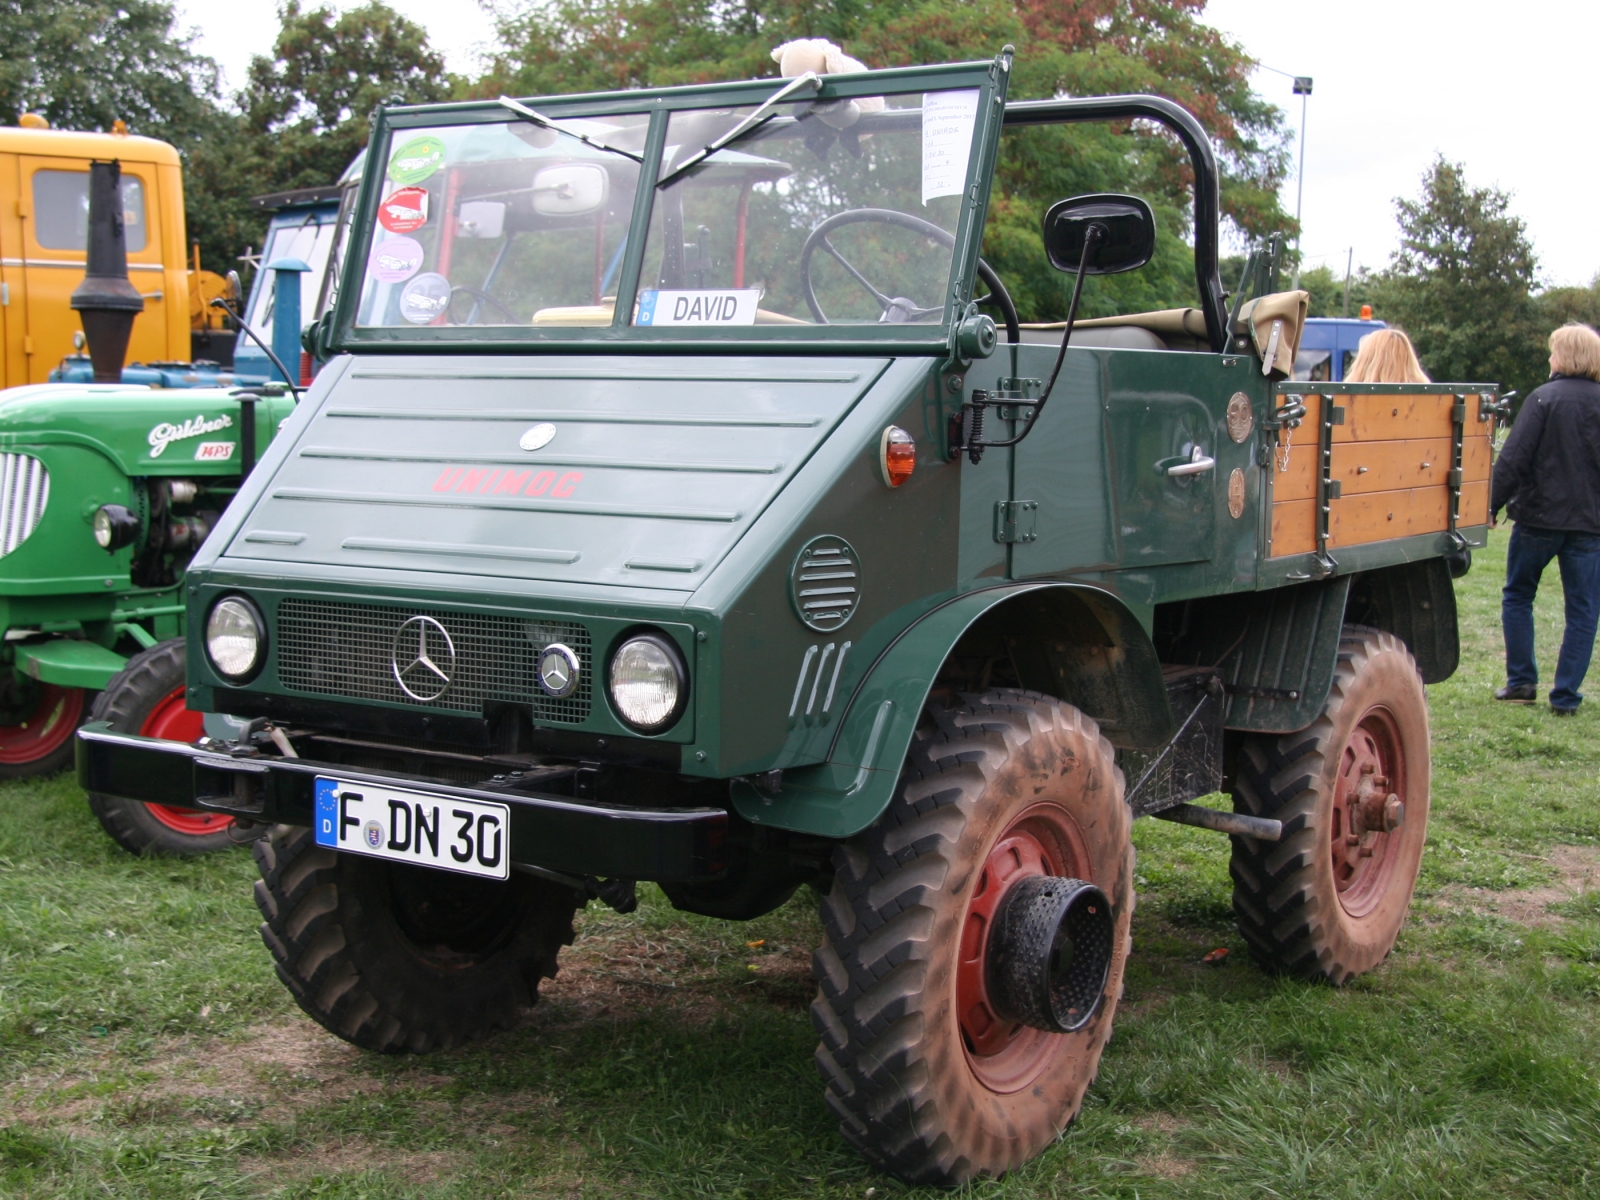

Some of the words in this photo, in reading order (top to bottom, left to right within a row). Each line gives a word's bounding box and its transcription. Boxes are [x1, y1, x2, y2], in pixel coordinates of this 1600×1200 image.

[937, 113, 962, 122] September
[642, 312, 650, 321] D
[673, 296, 737, 321] DAVID
[148, 413, 233, 458] Güldner
[431, 467, 585, 498] UNIMOG
[323, 819, 332, 833] D
[339, 791, 364, 841] F
[387, 799, 440, 857] DN
[450, 809, 501, 868] 30
